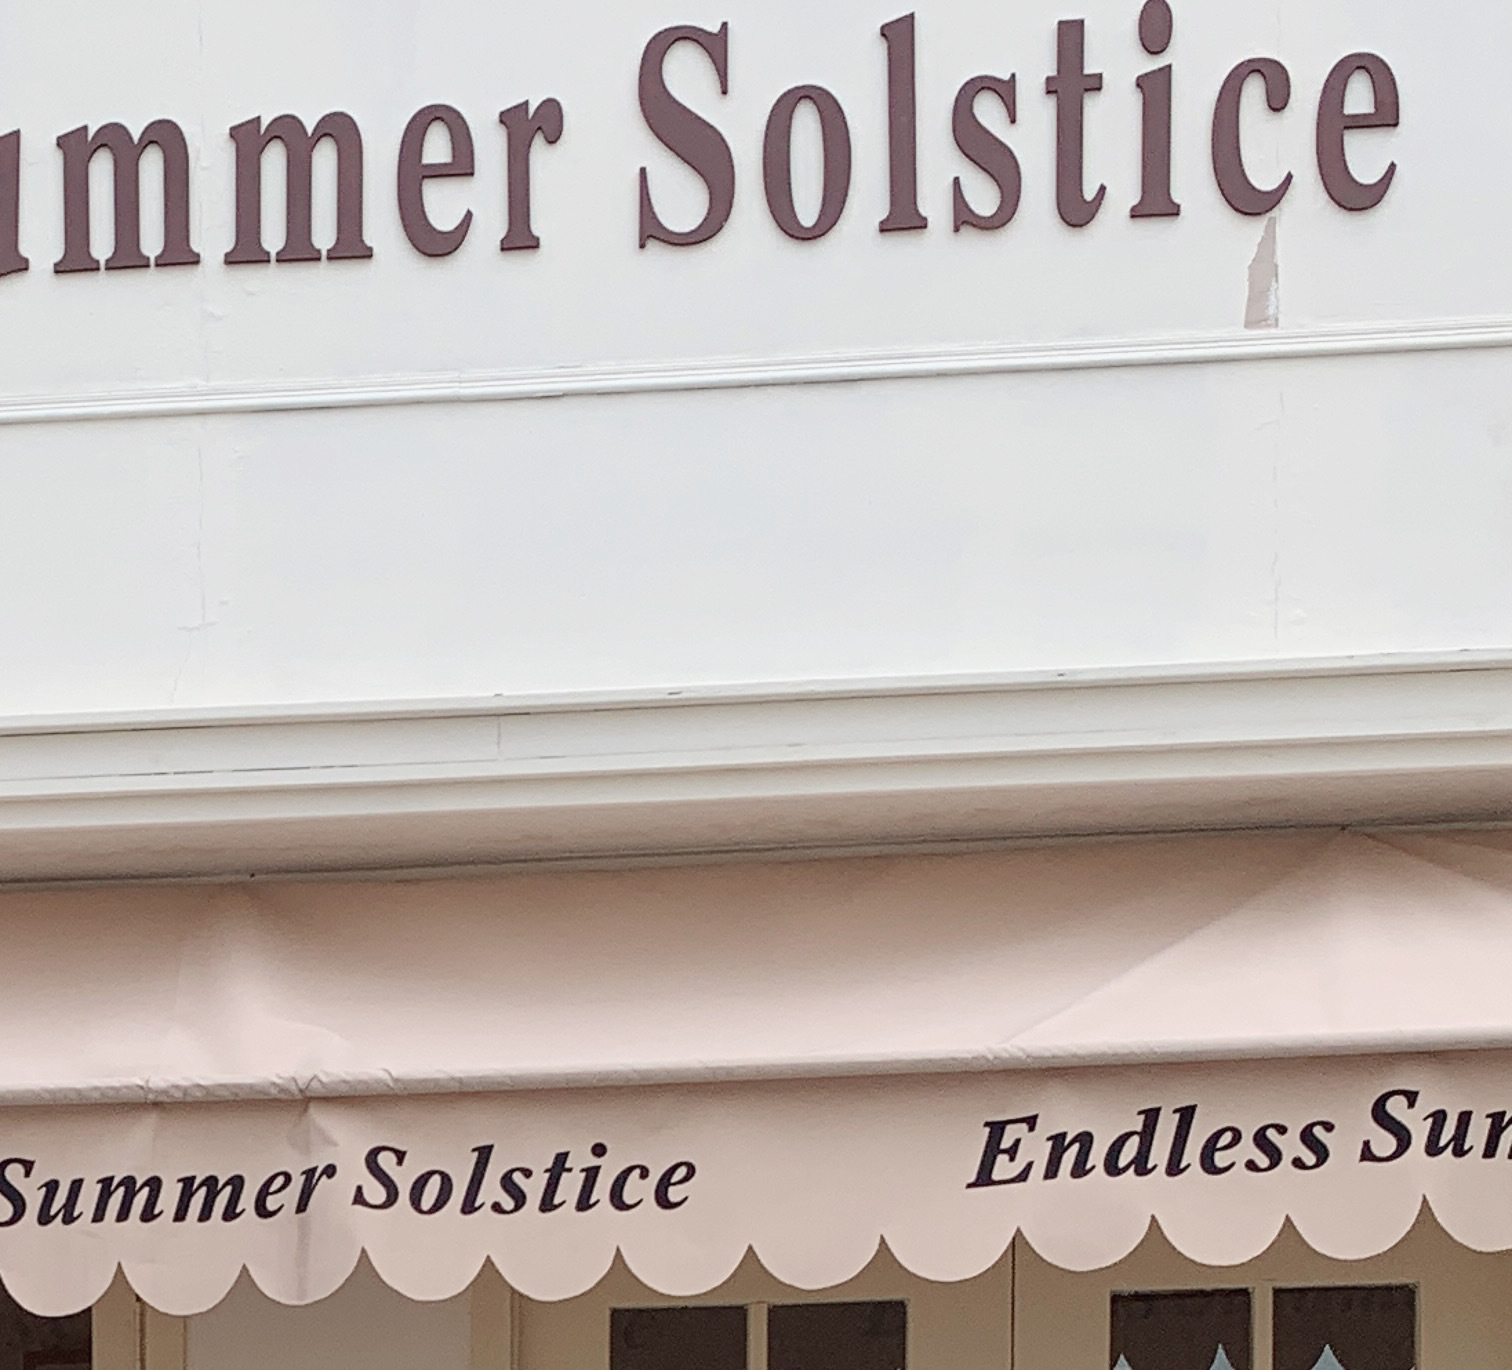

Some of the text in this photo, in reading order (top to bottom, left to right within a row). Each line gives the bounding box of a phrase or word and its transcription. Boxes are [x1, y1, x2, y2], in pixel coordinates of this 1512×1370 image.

[637, 0, 1401, 251] Solstice
[351, 1142, 697, 1216] Solstice
[965, 1103, 1336, 1189] Endless
